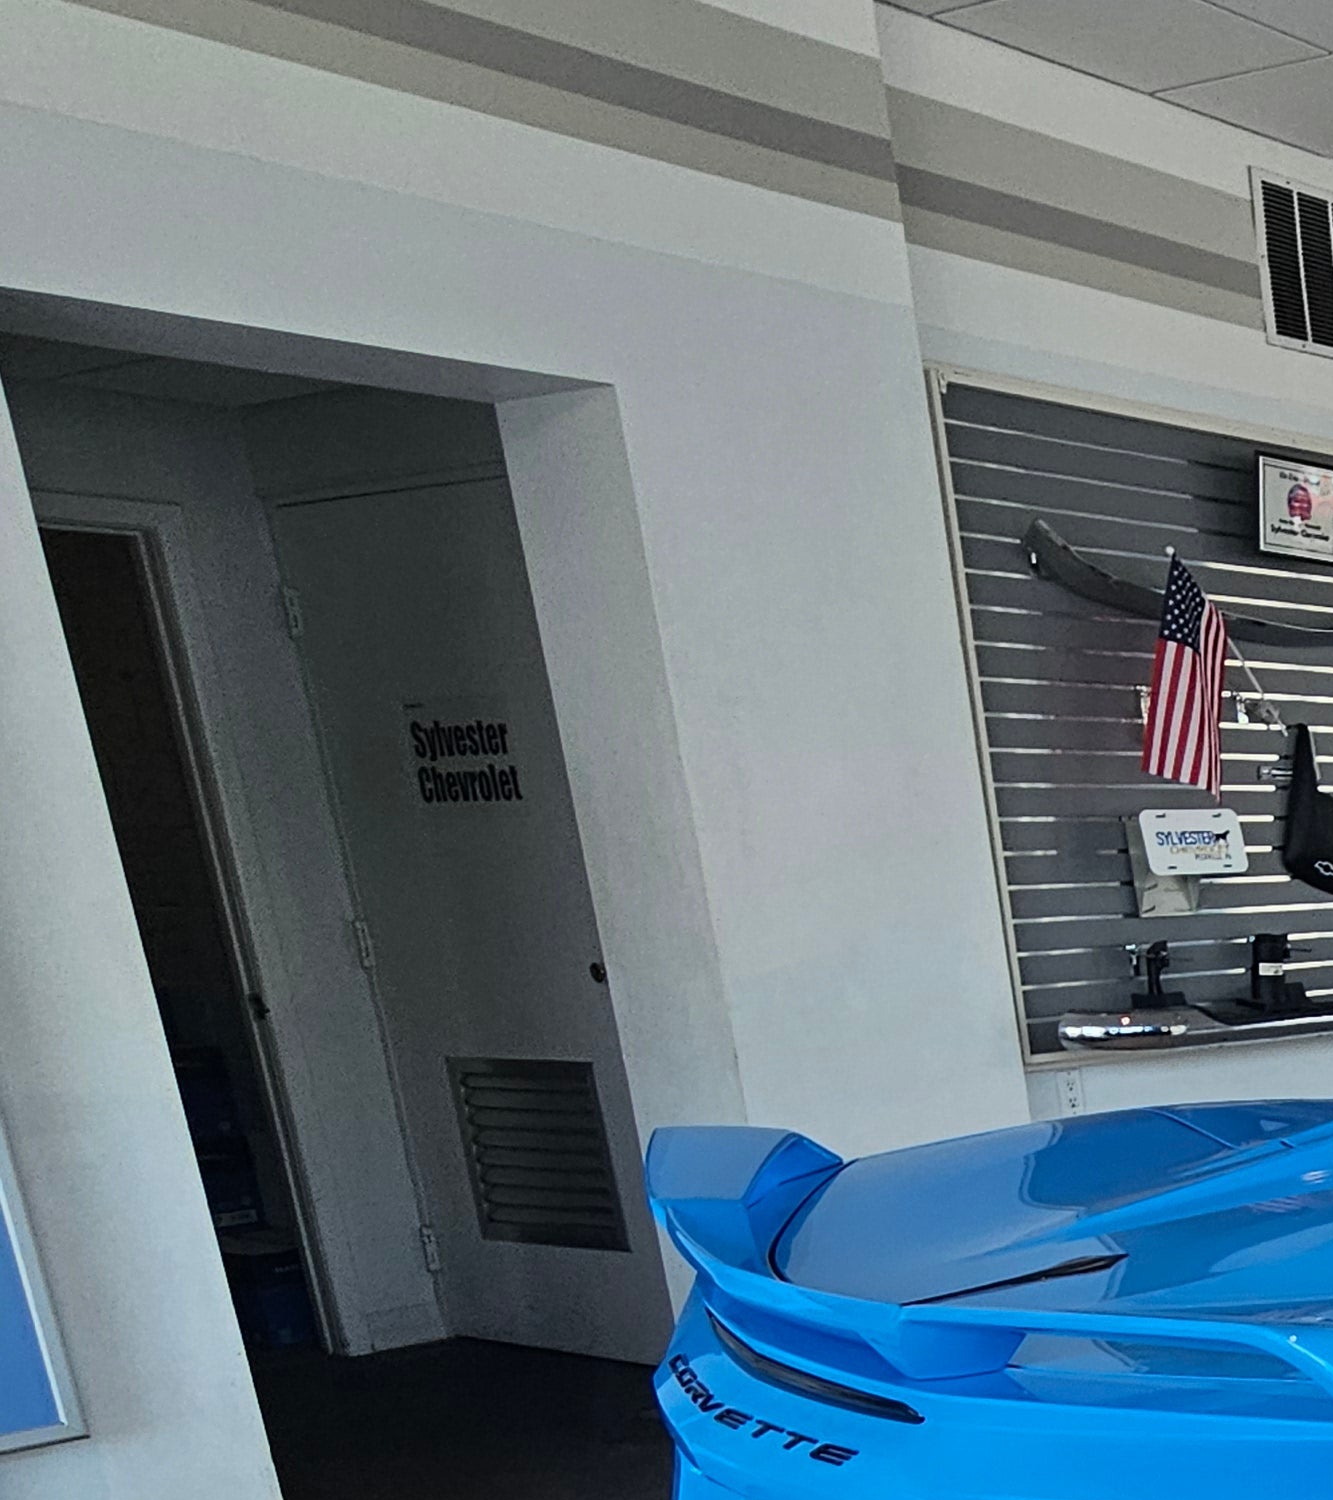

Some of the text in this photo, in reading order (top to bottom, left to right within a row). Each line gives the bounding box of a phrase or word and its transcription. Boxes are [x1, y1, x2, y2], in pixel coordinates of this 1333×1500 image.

[410, 720, 508, 761] Sylvester
[417, 764, 523, 804] Chevrolet
[668, 1353, 861, 1467] CORVETTE
